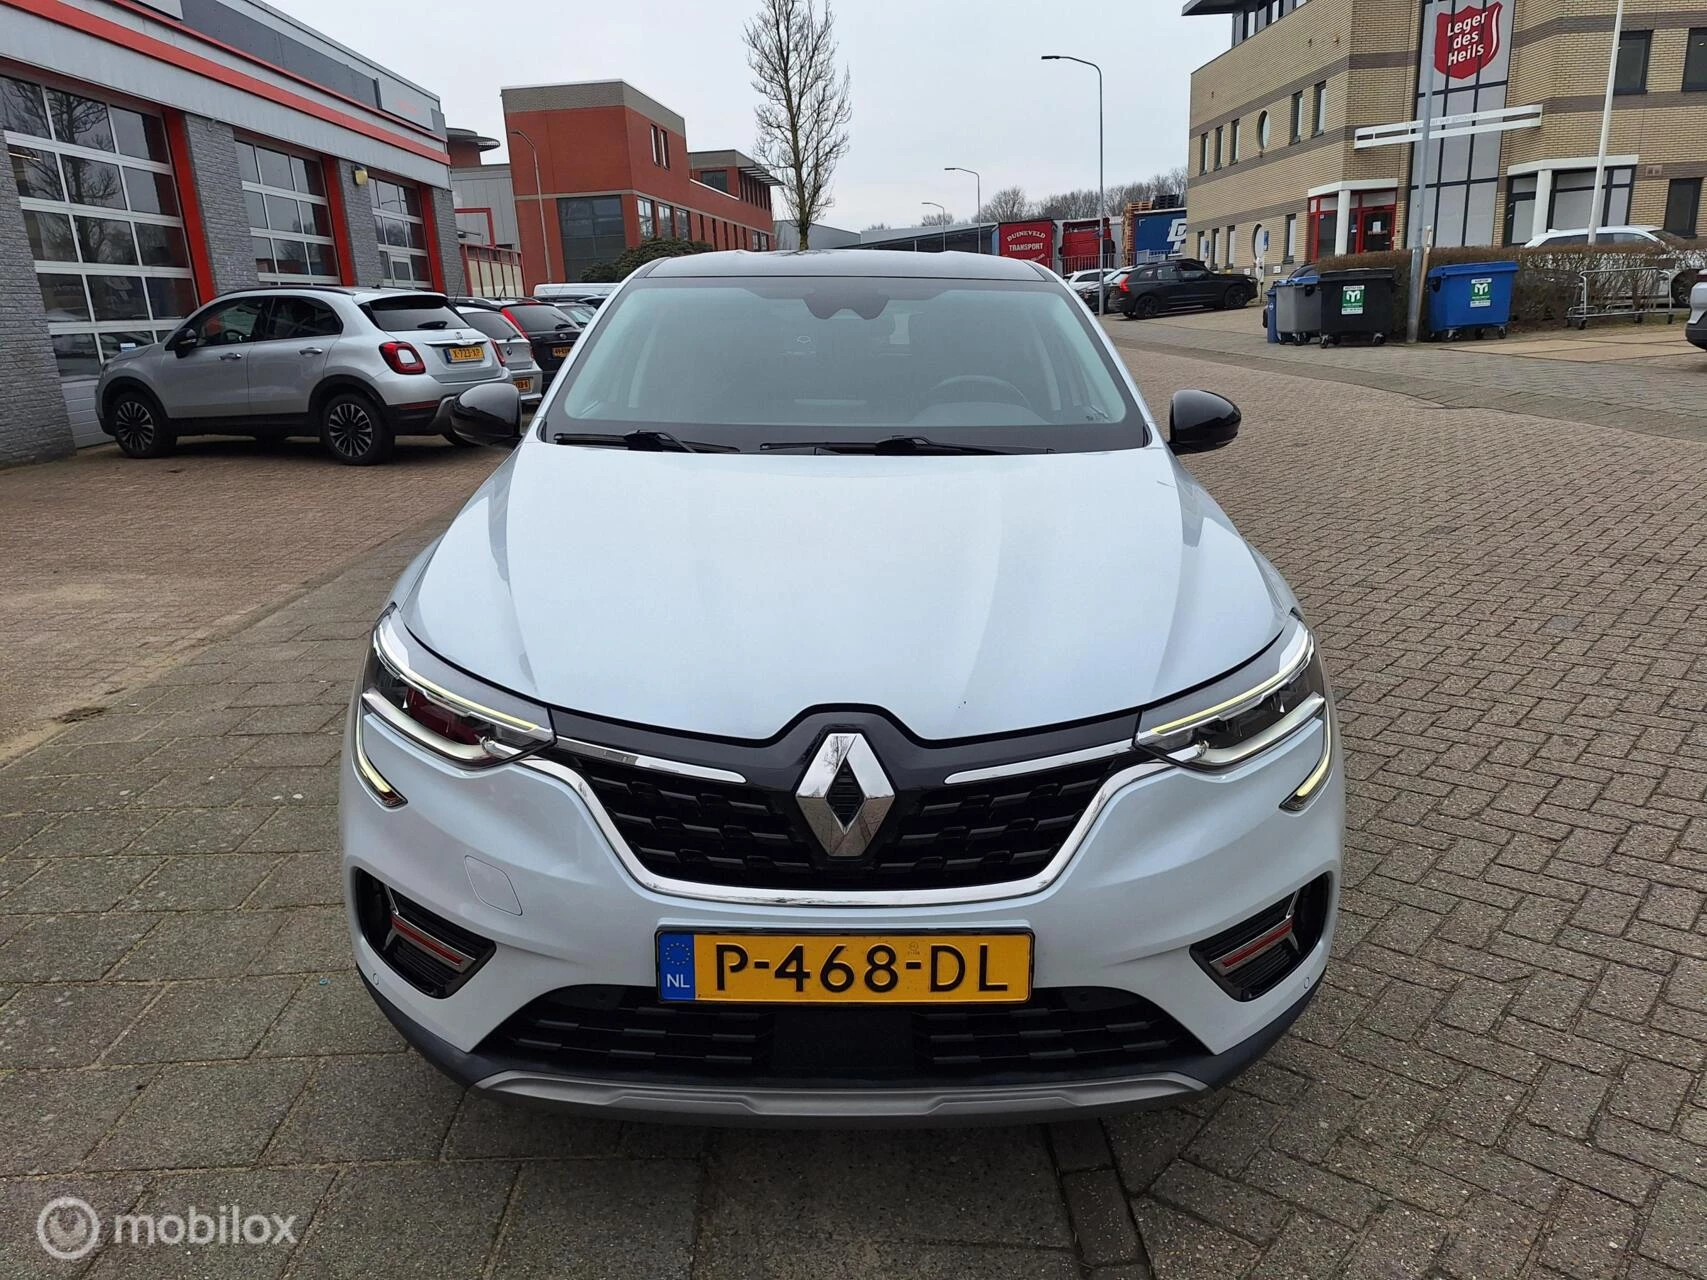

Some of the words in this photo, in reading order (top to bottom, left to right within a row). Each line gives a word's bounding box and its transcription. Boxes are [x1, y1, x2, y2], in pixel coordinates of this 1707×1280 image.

[1447, 11, 1488, 37] Leger
[1453, 30, 1479, 49] des
[1447, 43, 1485, 66] Heils
[1006, 230, 1046, 242] DUINEVELD
[1008, 242, 1044, 252] TRANSPORT
[715, 942, 1009, 993] P-468-DL
[666, 973, 691, 989] NL
